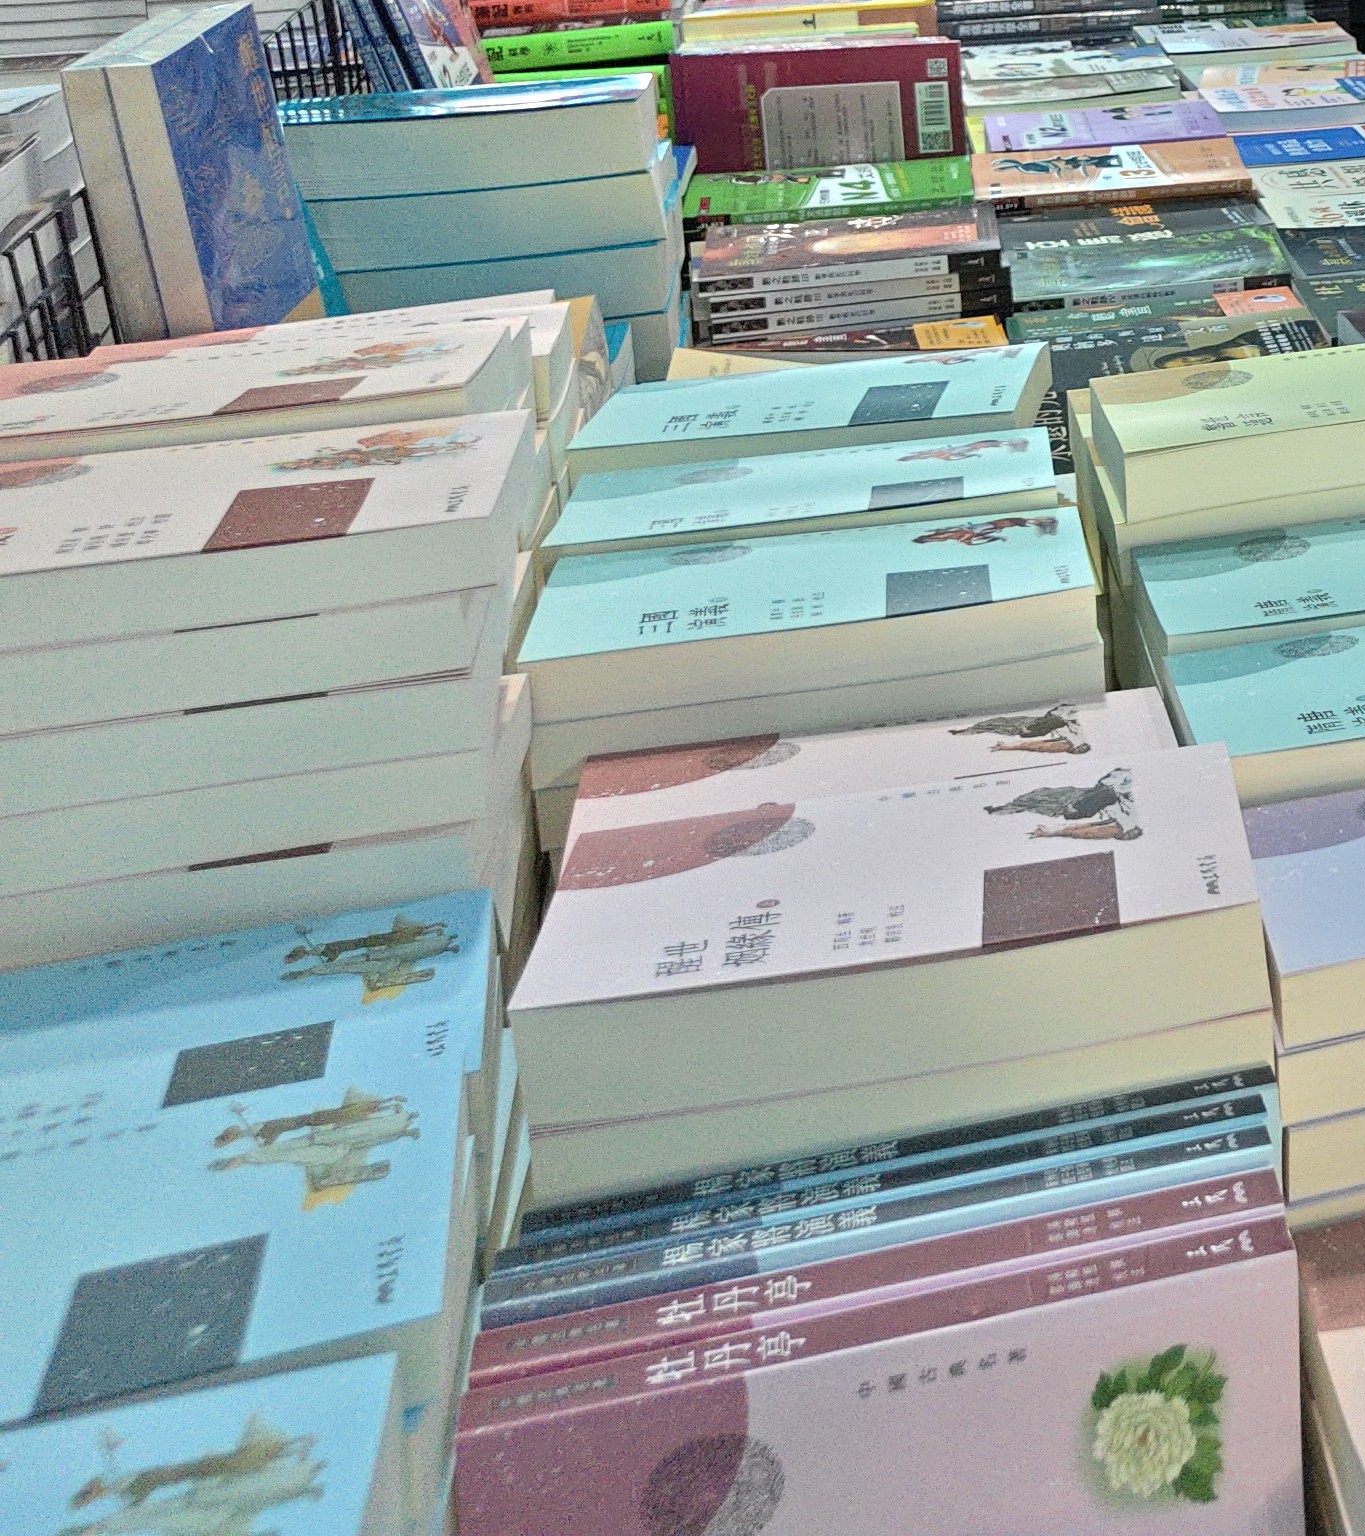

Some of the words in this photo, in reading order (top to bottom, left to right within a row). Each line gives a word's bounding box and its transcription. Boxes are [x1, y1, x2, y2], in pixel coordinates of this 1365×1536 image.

[838, 179, 880, 202] N4
[638, 610, 679, 636] 三國
[686, 603, 729, 630] 演義
[655, 939, 710, 978] 醒世
[721, 911, 782, 967] 姻緣傳
[670, 1172, 883, 1233] 楊家將演義
[661, 1204, 879, 1267] 楊家將演義
[655, 1273, 813, 1327] 牡丹亭
[645, 1330, 807, 1385] 牡丹亭
